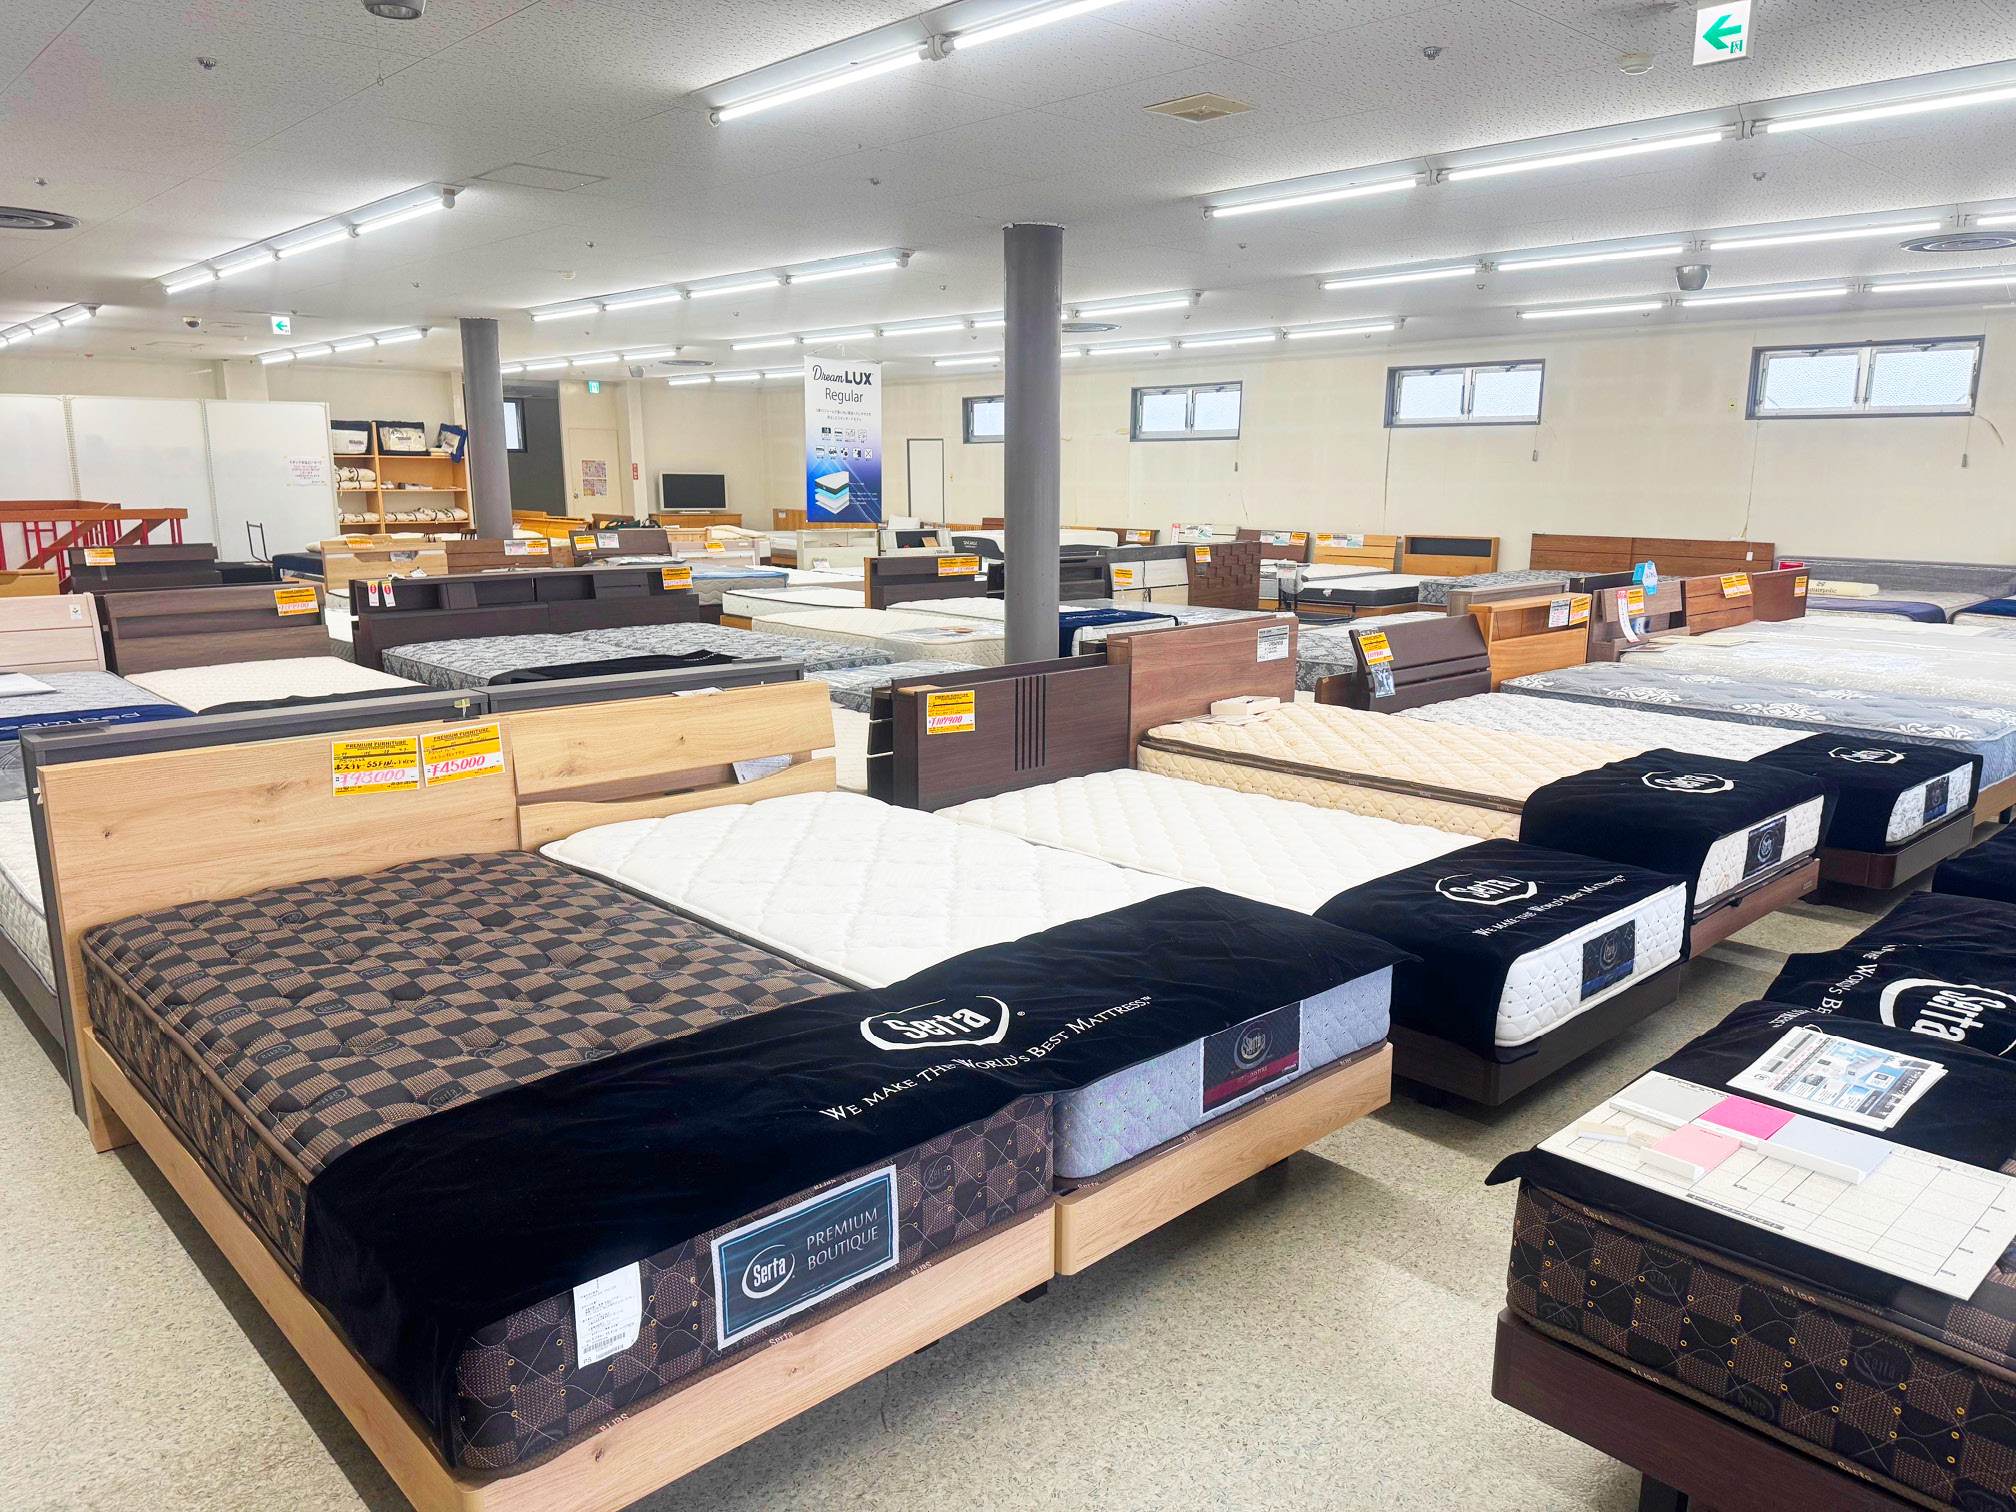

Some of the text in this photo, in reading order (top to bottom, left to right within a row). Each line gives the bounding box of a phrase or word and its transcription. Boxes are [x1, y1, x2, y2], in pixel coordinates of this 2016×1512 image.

[812, 364, 873, 386] Dream LUX
[825, 387, 864, 405] Regular
[1449, 879, 1521, 899] Serta
[883, 1007, 991, 1039] Serta
[1910, 990, 2007, 1042] Serta
[819, 1104, 864, 1121] WE
[862, 1078, 918, 1107] MAKE
[1025, 1030, 1069, 1059] BEST
[806, 1207, 878, 1251] PREMIUM
[807, 1225, 879, 1271] BOUTIQUE
[753, 1257, 786, 1287] Serta
